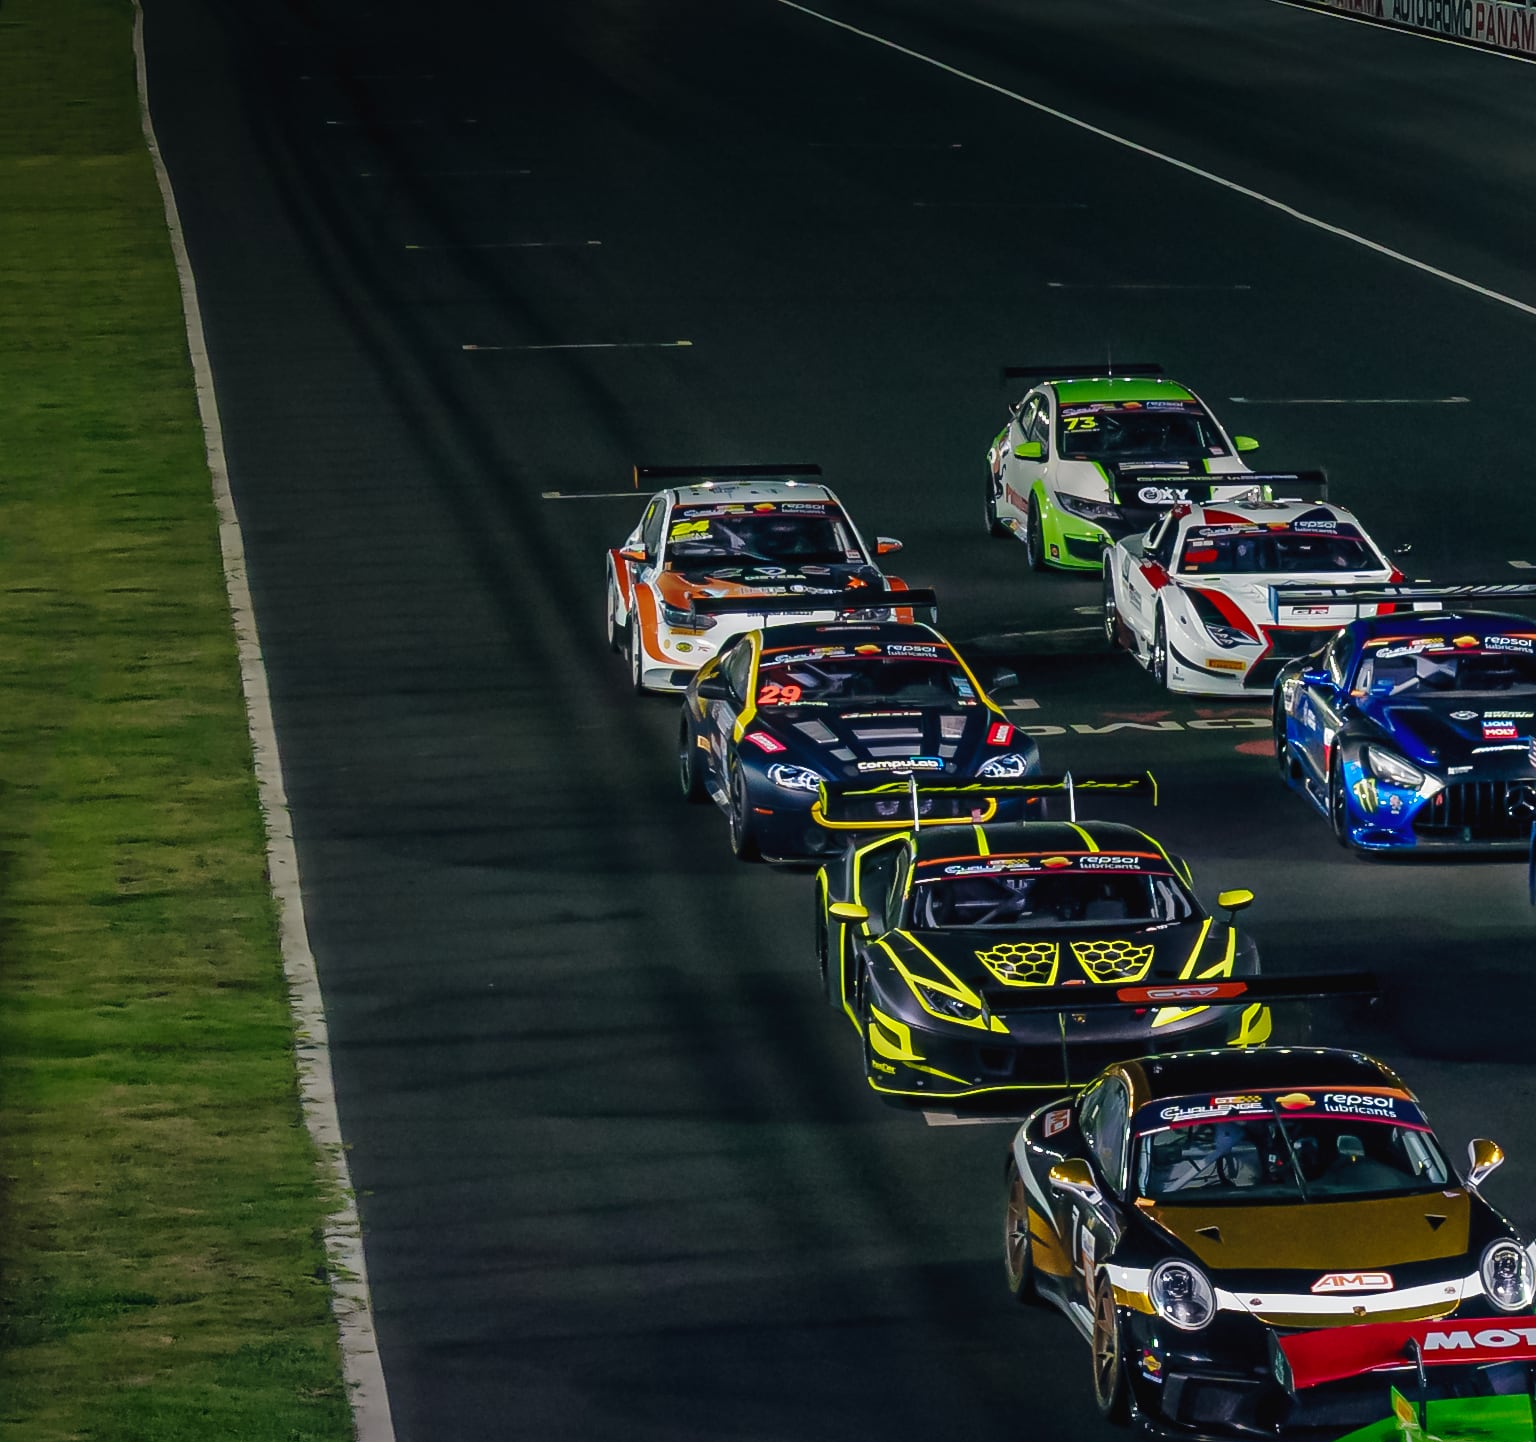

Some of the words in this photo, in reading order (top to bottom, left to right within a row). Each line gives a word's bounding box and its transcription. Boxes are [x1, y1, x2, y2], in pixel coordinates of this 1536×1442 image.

[1063, 416, 1097, 431] 73
[1484, 636, 1532, 646] repsol
[886, 644, 936, 654] repsol
[757, 685, 802, 704] 29
[1483, 728, 1516, 736] MOLY
[1079, 856, 1139, 866] repsol
[1323, 1093, 1395, 1108] repsol
[1324, 1104, 1397, 1118] lubricants
